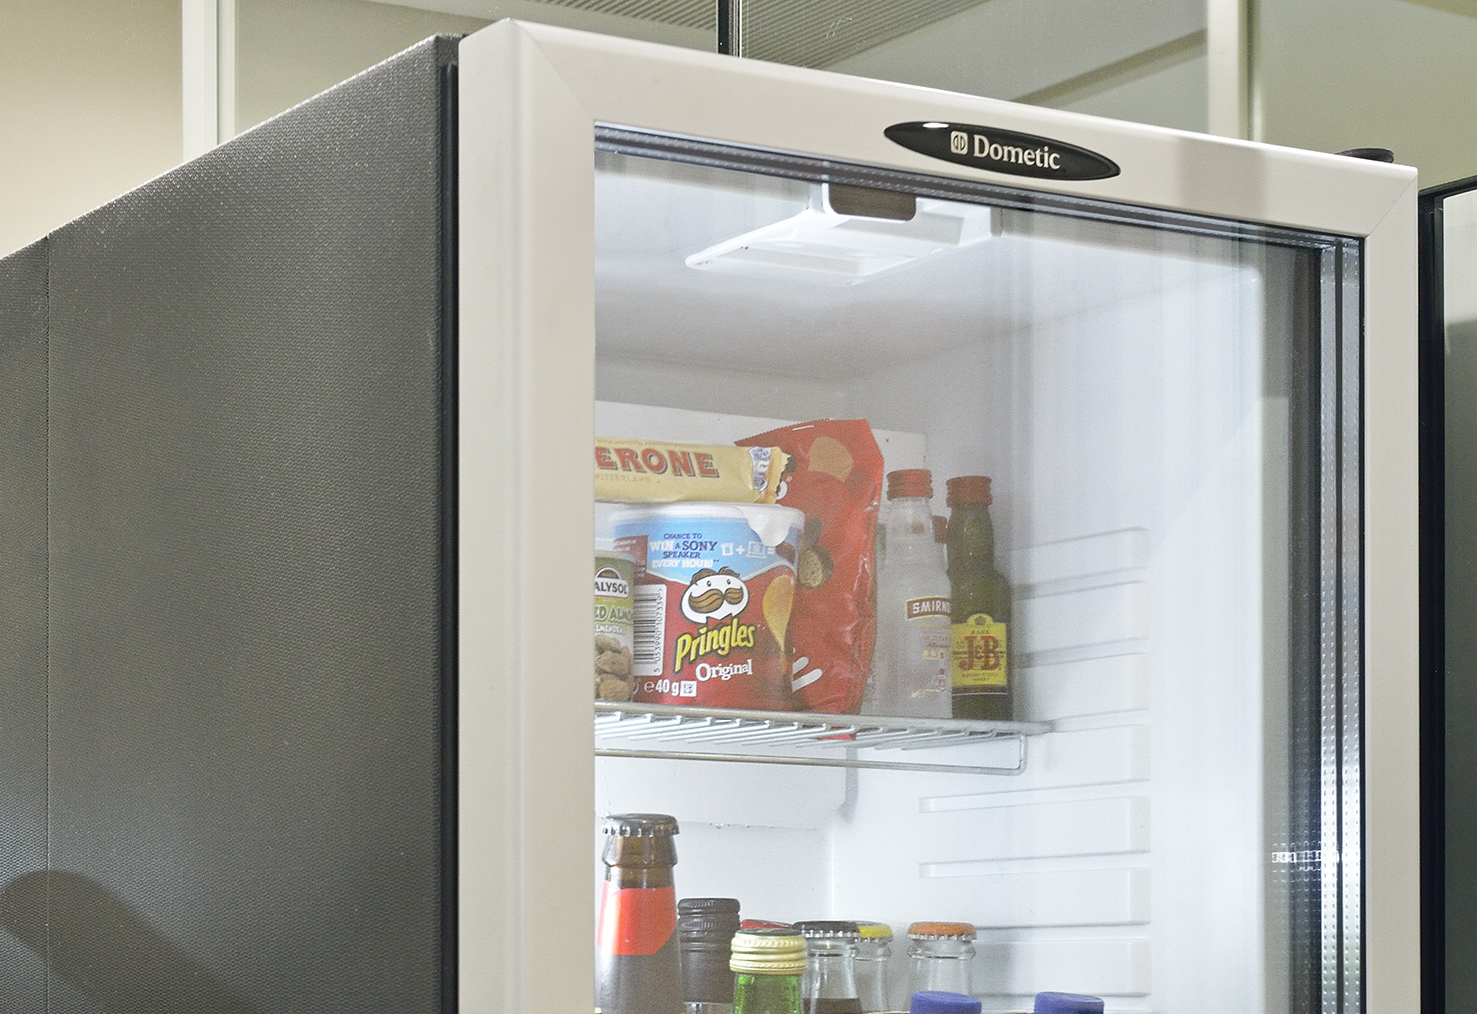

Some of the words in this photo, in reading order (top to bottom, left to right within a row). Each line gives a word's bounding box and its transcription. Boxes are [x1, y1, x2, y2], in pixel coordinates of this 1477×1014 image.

[973, 134, 1061, 170] Dometic
[596, 446, 720, 478] ERONE
[649, 540, 674, 551] WIN
[682, 541, 718, 551] SONY
[652, 560, 680, 568] EVERY
[912, 600, 952, 614] SMIRN
[674, 618, 755, 673] Pringles
[695, 659, 753, 681] Original
